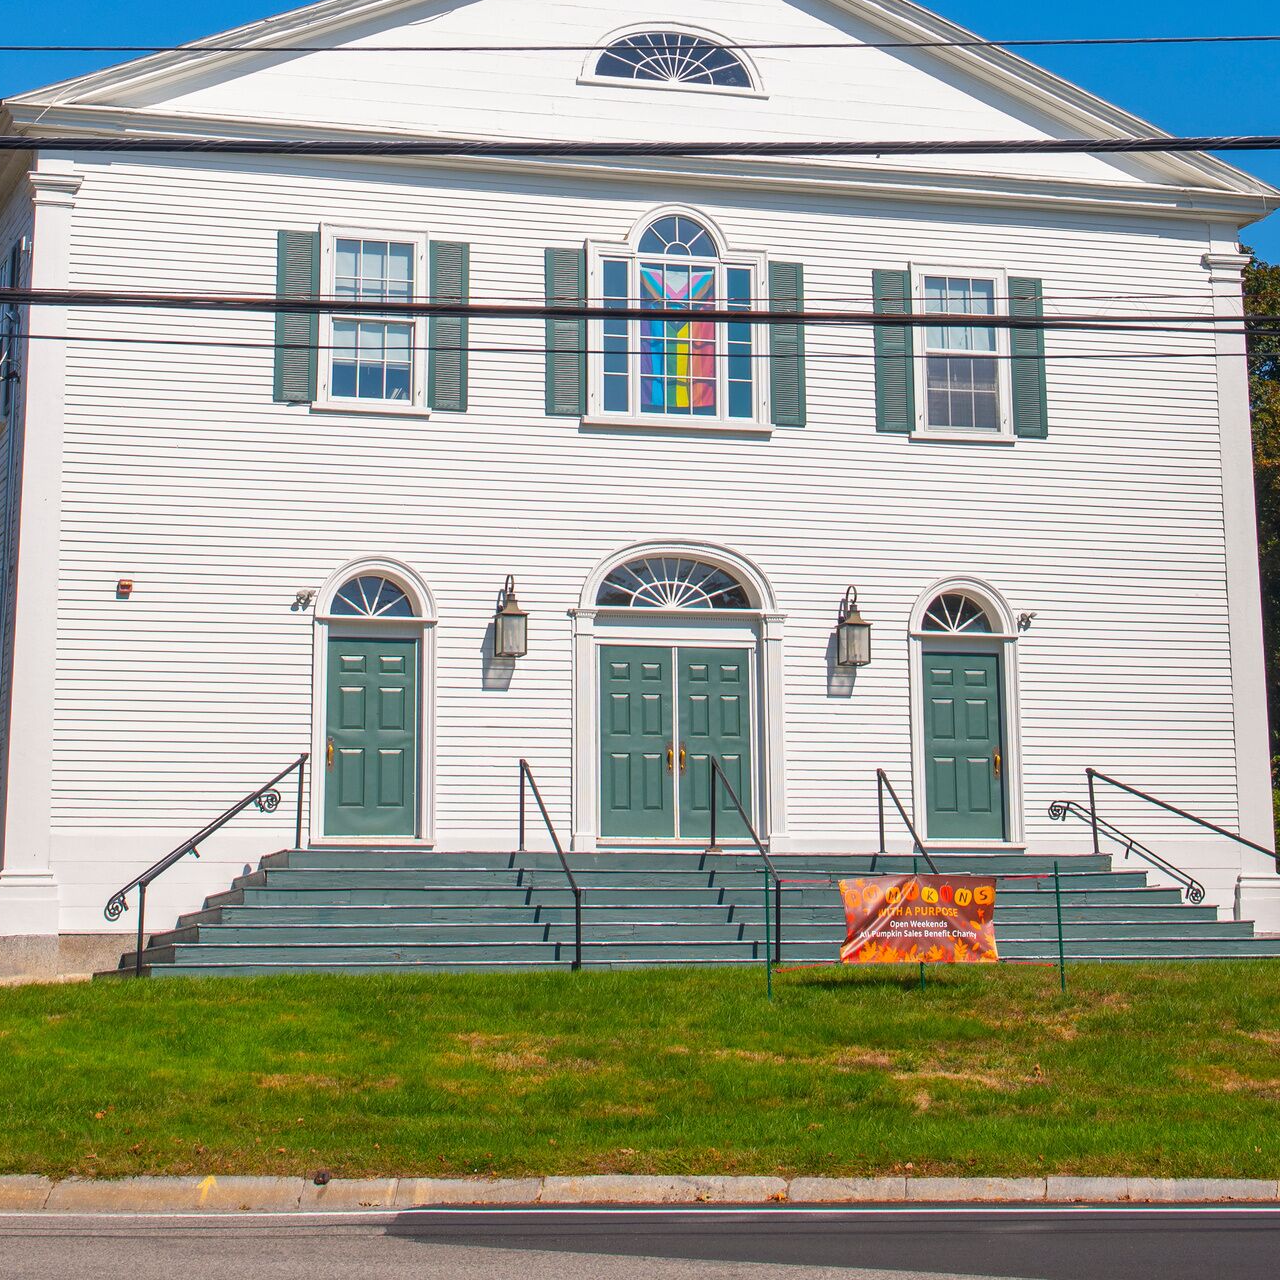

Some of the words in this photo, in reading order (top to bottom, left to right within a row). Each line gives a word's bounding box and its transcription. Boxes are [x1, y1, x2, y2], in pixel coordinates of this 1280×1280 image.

[905, 906, 913, 916] A
[914, 906, 959, 918] PURPOSE
[890, 920, 909, 929] Open
[910, 920, 948, 928] Weekends
[952, 930, 977, 939] Charity
